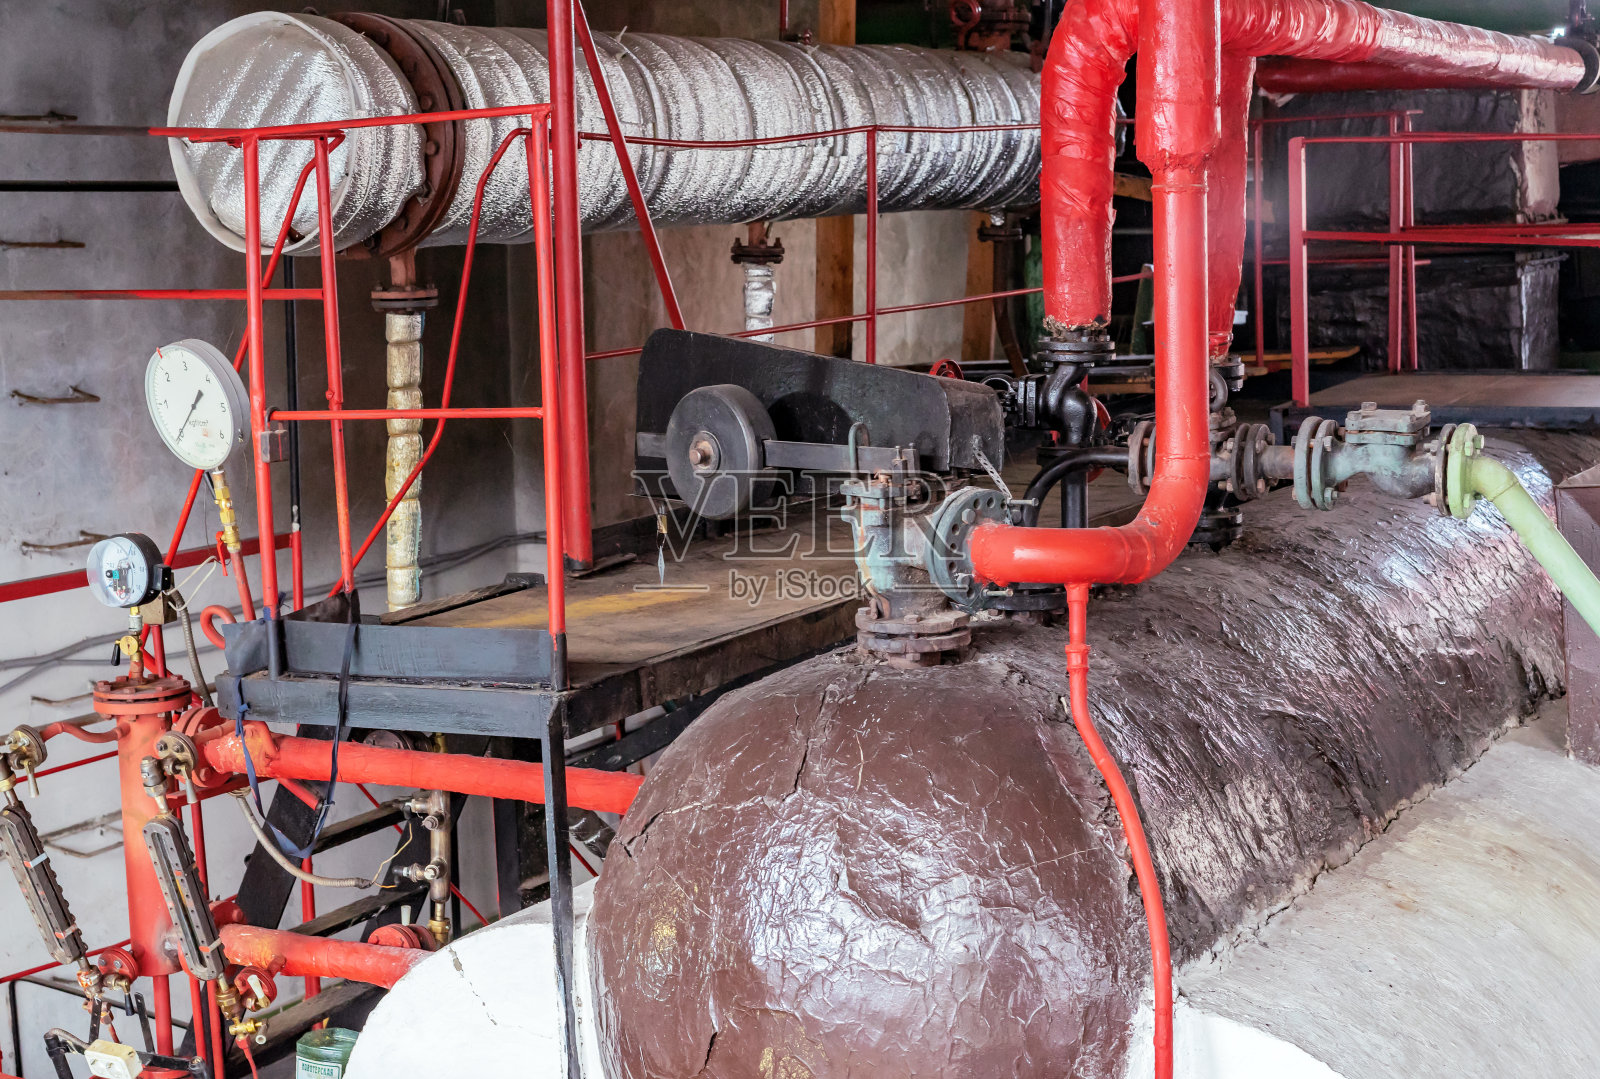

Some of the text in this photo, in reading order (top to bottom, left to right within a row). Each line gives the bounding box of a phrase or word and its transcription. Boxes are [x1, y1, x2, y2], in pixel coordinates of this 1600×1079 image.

[183, 361, 188, 371] 3
[165, 372, 171, 382] 2
[206, 374, 211, 384] 4
[221, 402, 226, 413] 5
[220, 430, 224, 440] 6
